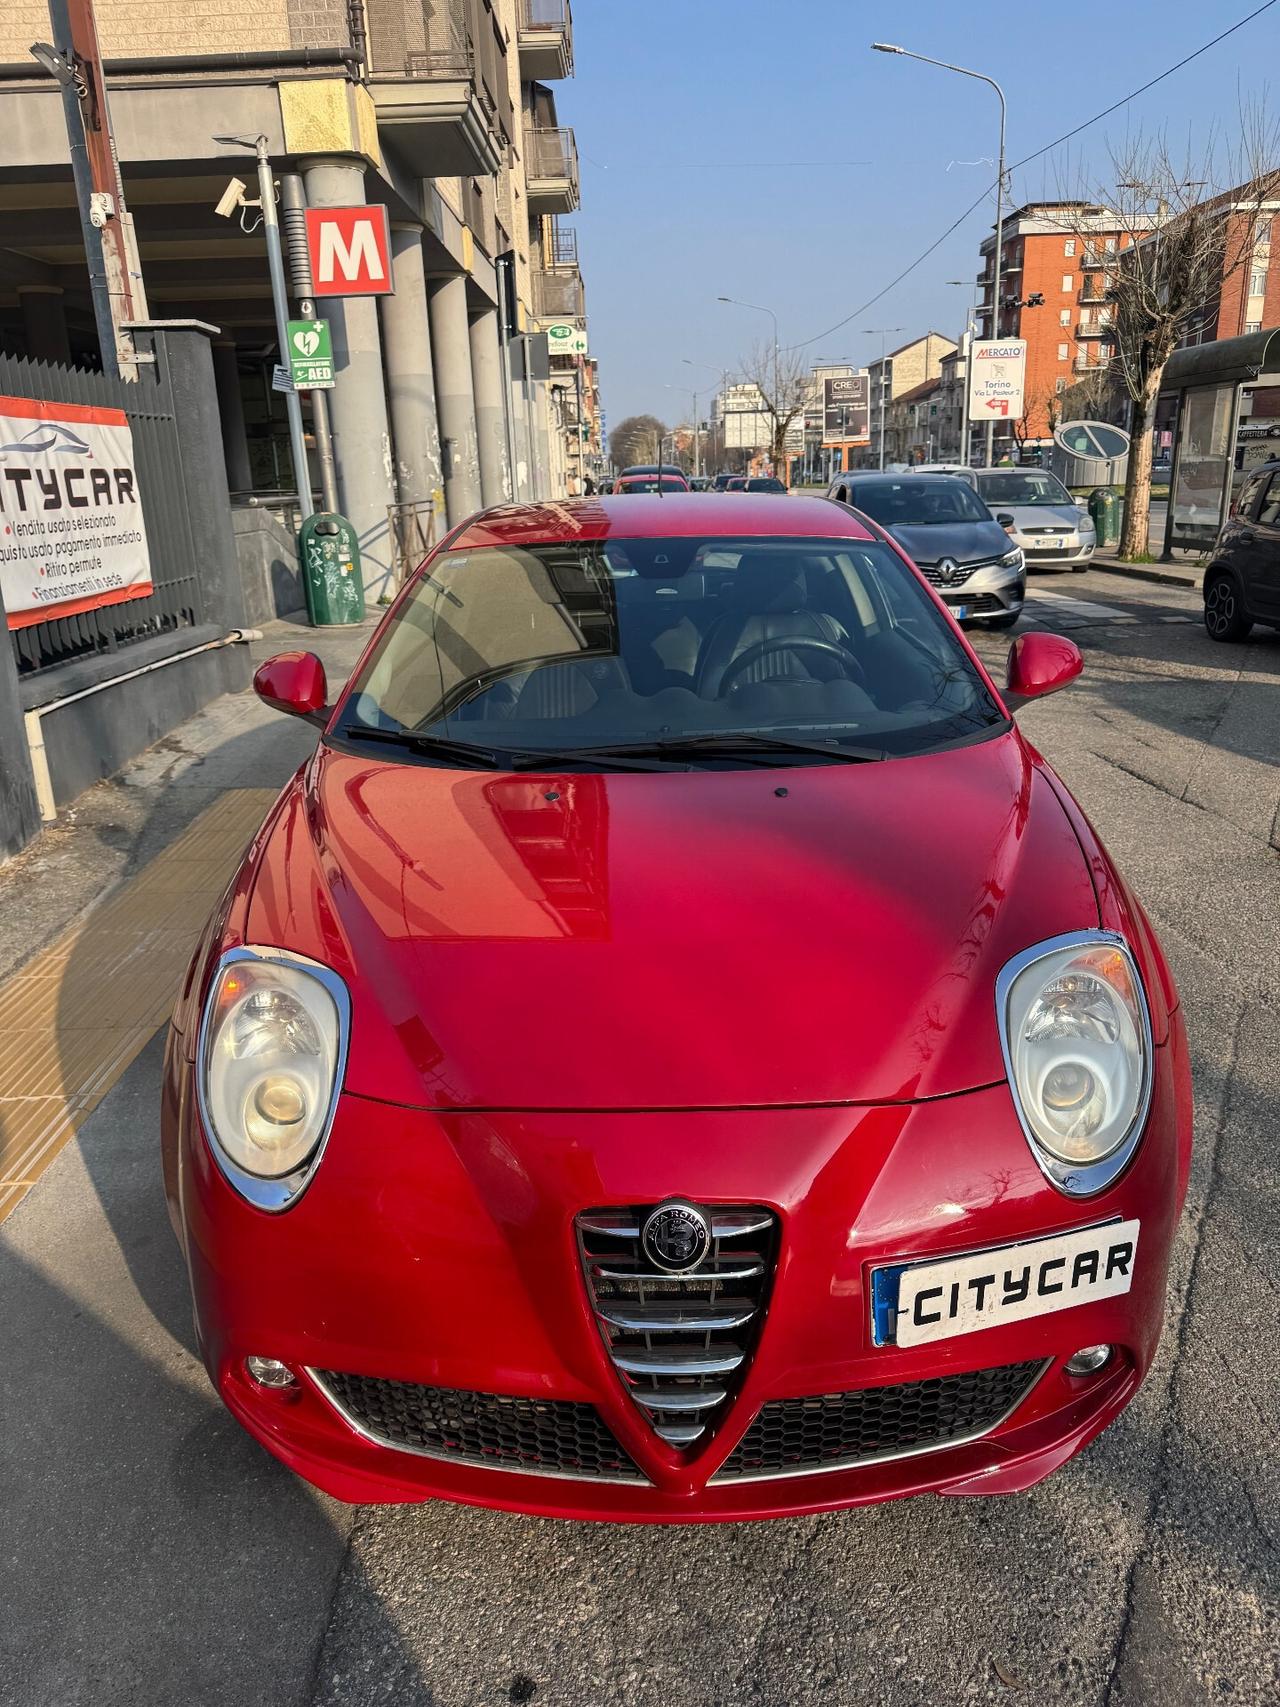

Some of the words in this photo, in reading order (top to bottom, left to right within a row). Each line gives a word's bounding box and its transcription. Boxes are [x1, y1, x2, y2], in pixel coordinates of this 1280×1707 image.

[319, 220, 384, 282] M
[308, 367, 331, 380] AED
[984, 380, 1011, 389] Torino
[0, 468, 136, 512] TYCAR
[48, 517, 71, 533] usato
[72, 513, 116, 530] selezionato
[29, 541, 52, 558] usato
[56, 535, 101, 558] pagamento
[102, 530, 142, 547] immediato
[45, 561, 67, 578] Ritiro
[69, 556, 102, 577] permute
[35, 576, 95, 601] Finanziamenti
[96, 577, 104, 591] in
[104, 572, 123, 588] sede
[670, 1210, 705, 1239] ROMEO
[913, 1241, 1133, 1326] CITYCAR
